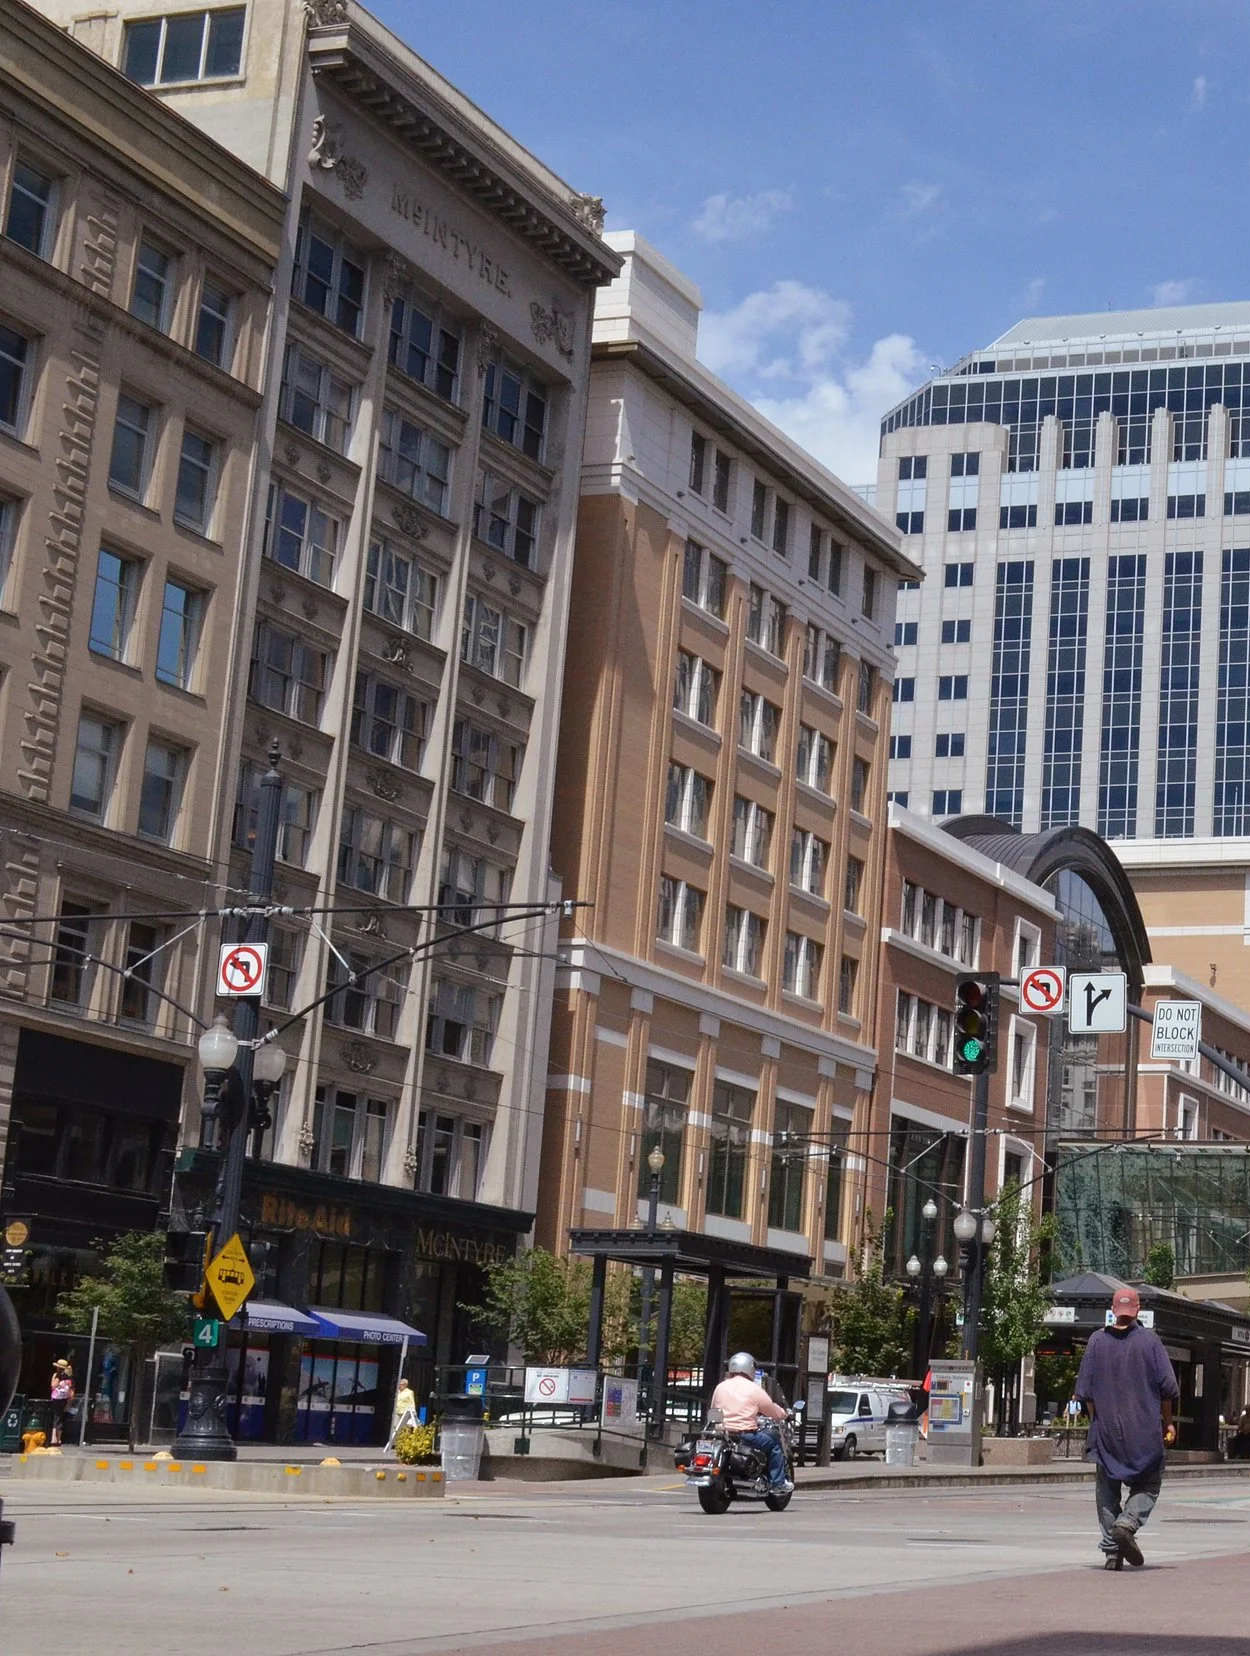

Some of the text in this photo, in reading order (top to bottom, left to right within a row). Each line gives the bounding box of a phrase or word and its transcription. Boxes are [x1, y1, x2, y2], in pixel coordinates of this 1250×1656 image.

[1158, 1008, 1197, 1021] DO NOT
[1156, 1026, 1194, 1040] BLOCK
[1155, 1043, 1194, 1053] INTERSECTION
[247, 1317, 294, 1331] PRESCRIPTIONS
[198, 1324, 213, 1344] 4
[363, 1330, 403, 1344] PHOTO CENTER
[472, 1373, 480, 1382] P
